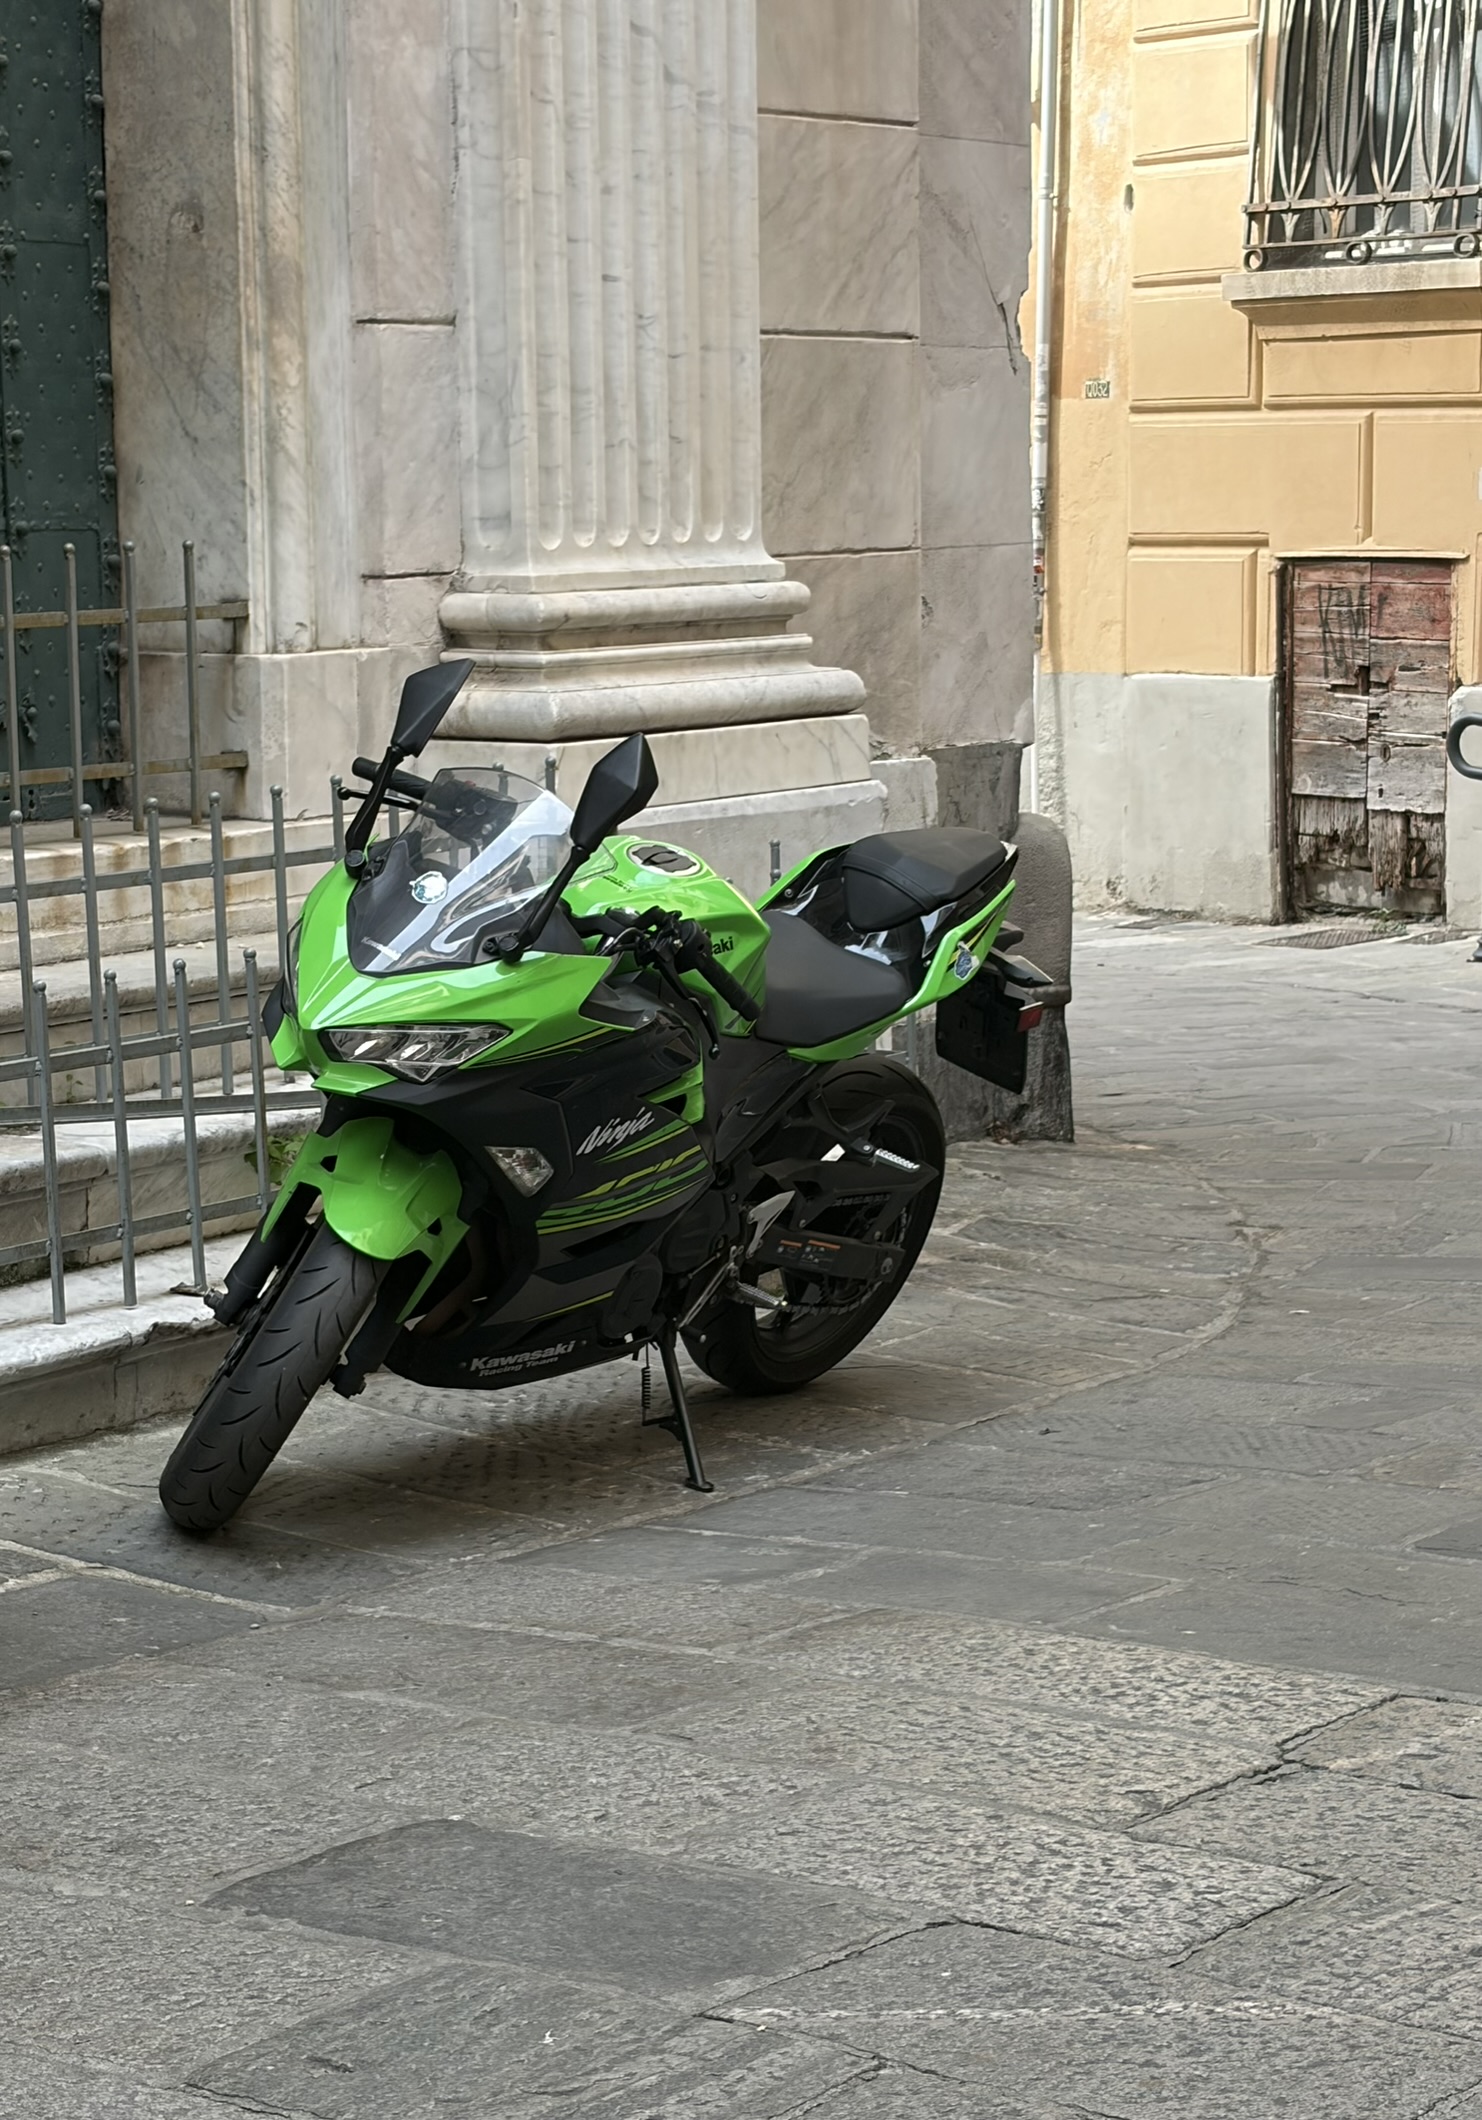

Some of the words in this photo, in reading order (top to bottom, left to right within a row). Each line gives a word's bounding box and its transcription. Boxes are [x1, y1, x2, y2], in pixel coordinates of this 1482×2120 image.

[711, 936, 734, 955] aki
[576, 1106, 655, 1156] Ninja
[470, 1340, 576, 1371] Kawasaki
[478, 1364, 523, 1377] Racing
[525, 1356, 559, 1368] Team
